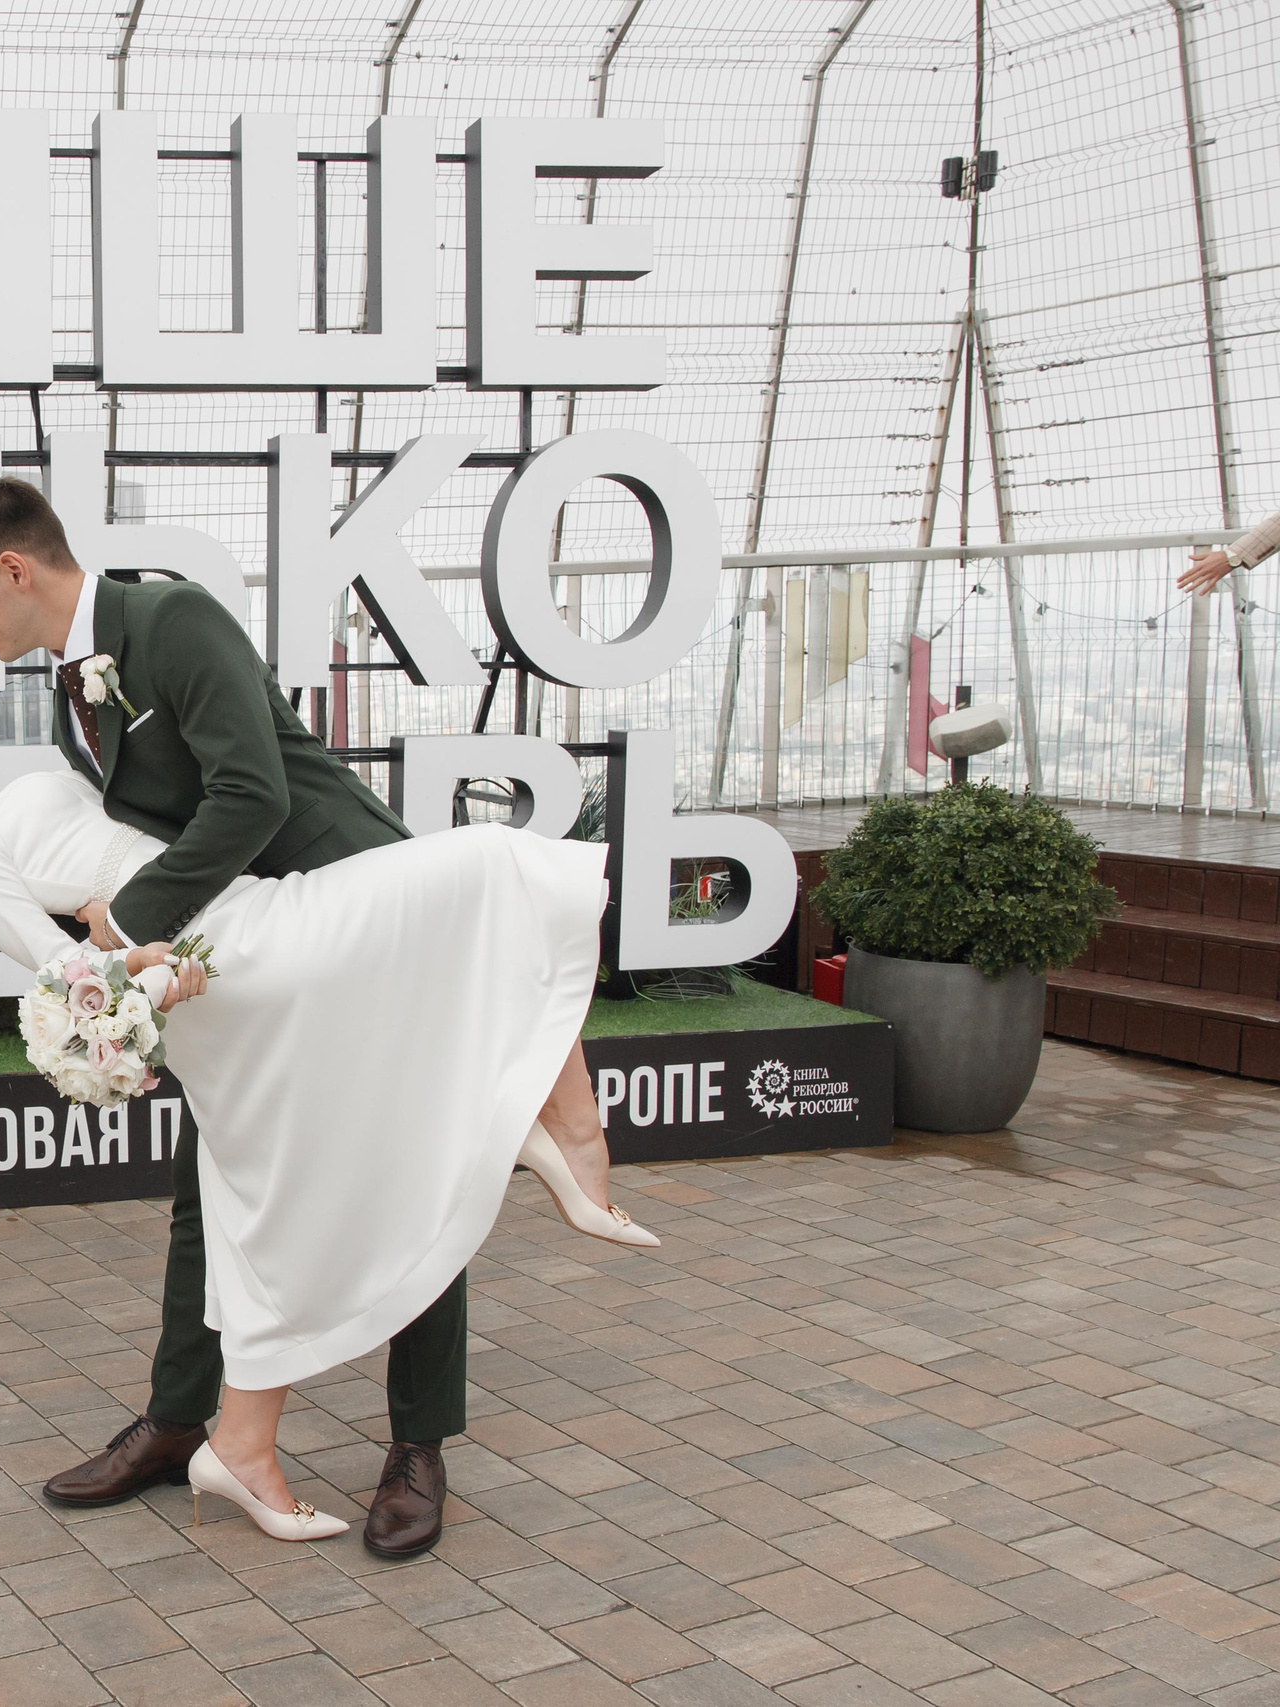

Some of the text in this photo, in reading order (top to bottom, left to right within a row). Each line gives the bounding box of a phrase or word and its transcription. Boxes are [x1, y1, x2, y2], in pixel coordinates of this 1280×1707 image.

[793, 1067, 830, 1081] КНИГА
[597, 1061, 725, 1129] РОПЕ
[792, 1081, 849, 1097] РЕКОРДОВ
